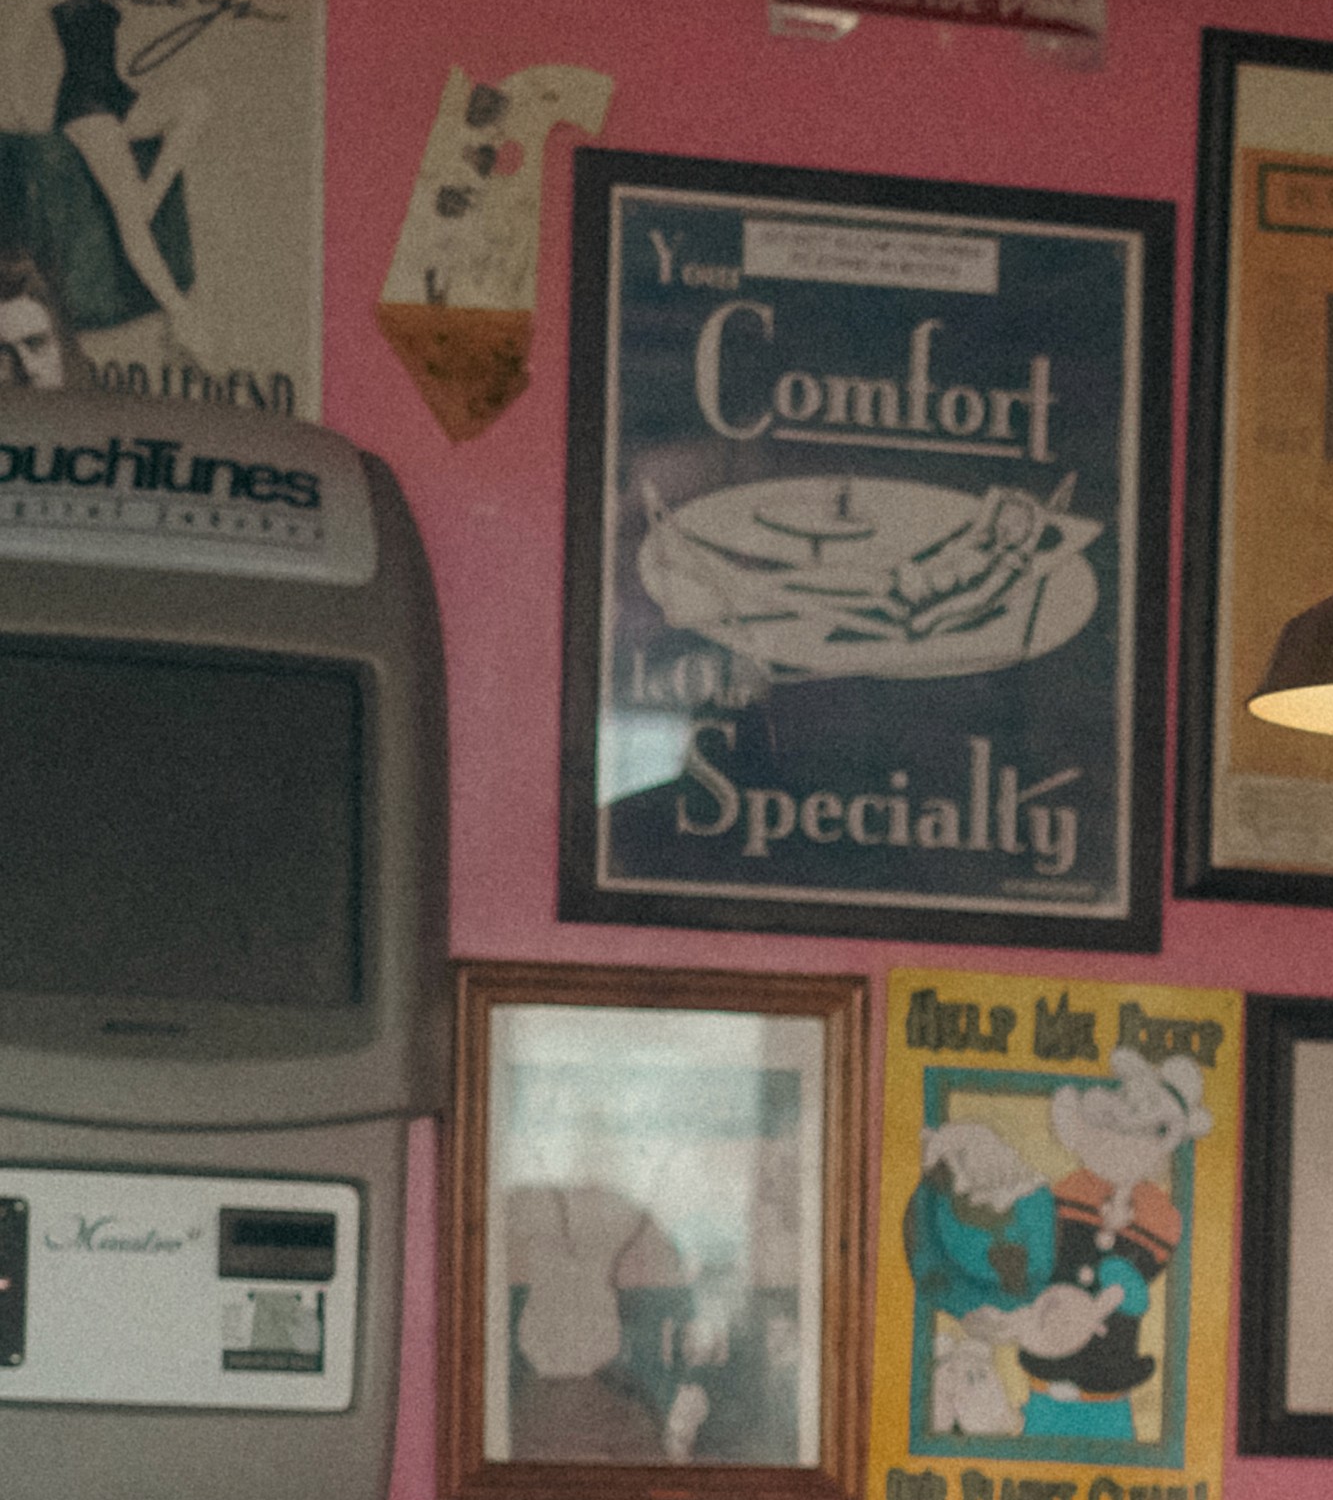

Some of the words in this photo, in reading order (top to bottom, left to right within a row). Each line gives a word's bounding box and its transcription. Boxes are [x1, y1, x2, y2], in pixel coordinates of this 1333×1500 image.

[695, 299, 1060, 465] Comfort
[0, 437, 321, 510] ouchTunes
[677, 720, 1083, 876] Specialty
[907, 989, 1015, 1053] HELP
[1033, 990, 1097, 1061] ME
